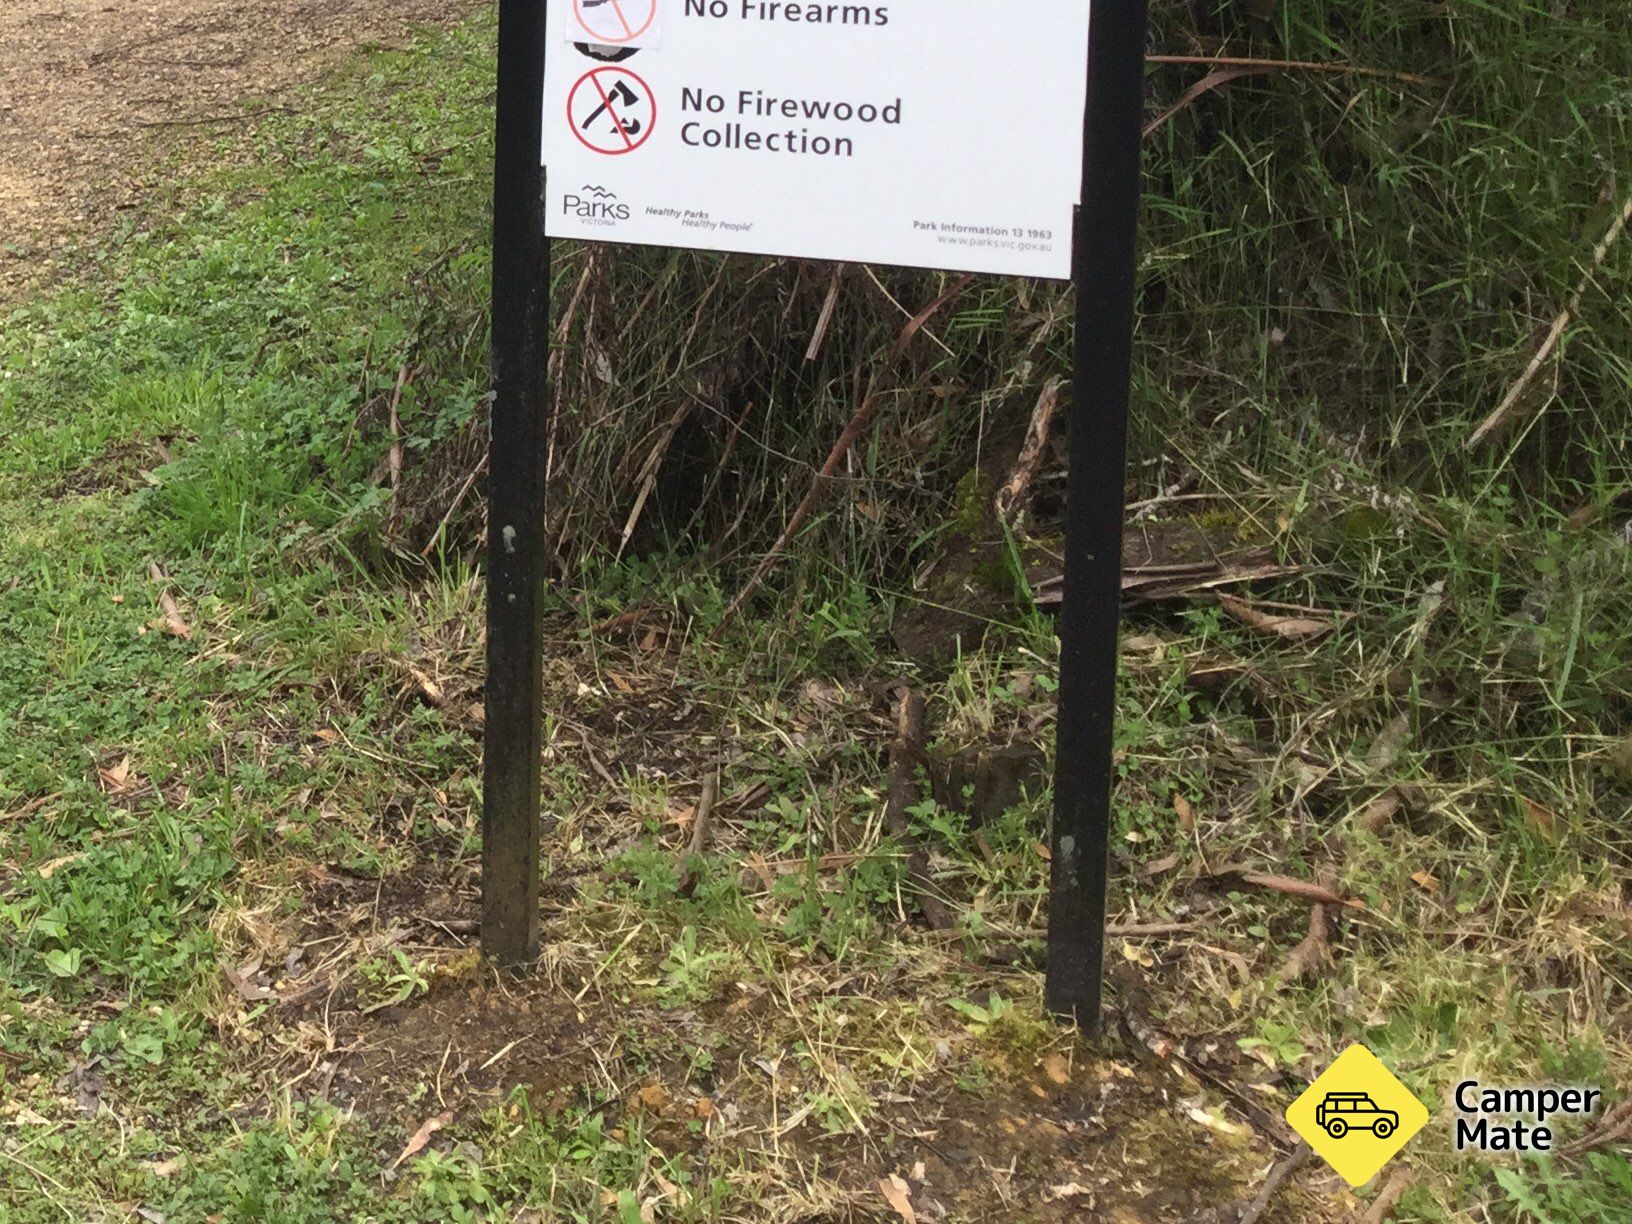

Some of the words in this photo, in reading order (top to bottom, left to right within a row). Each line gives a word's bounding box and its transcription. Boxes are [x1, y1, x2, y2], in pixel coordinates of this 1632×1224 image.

[681, 87, 725, 114] No
[738, 90, 902, 124] Firewood
[680, 121, 854, 157] Collection
[563, 194, 630, 221] Parks
[645, 206, 682, 219] Healthy
[684, 209, 710, 220] Parks
[580, 217, 617, 227] VICTORIA
[681, 217, 718, 230] Healthy
[913, 220, 937, 231] Park
[940, 222, 1009, 237] Information
[1012, 228, 1023, 238] 13
[1027, 229, 1053, 240] 1963
[937, 235, 1053, 252] www.parks.vic.gov.au
